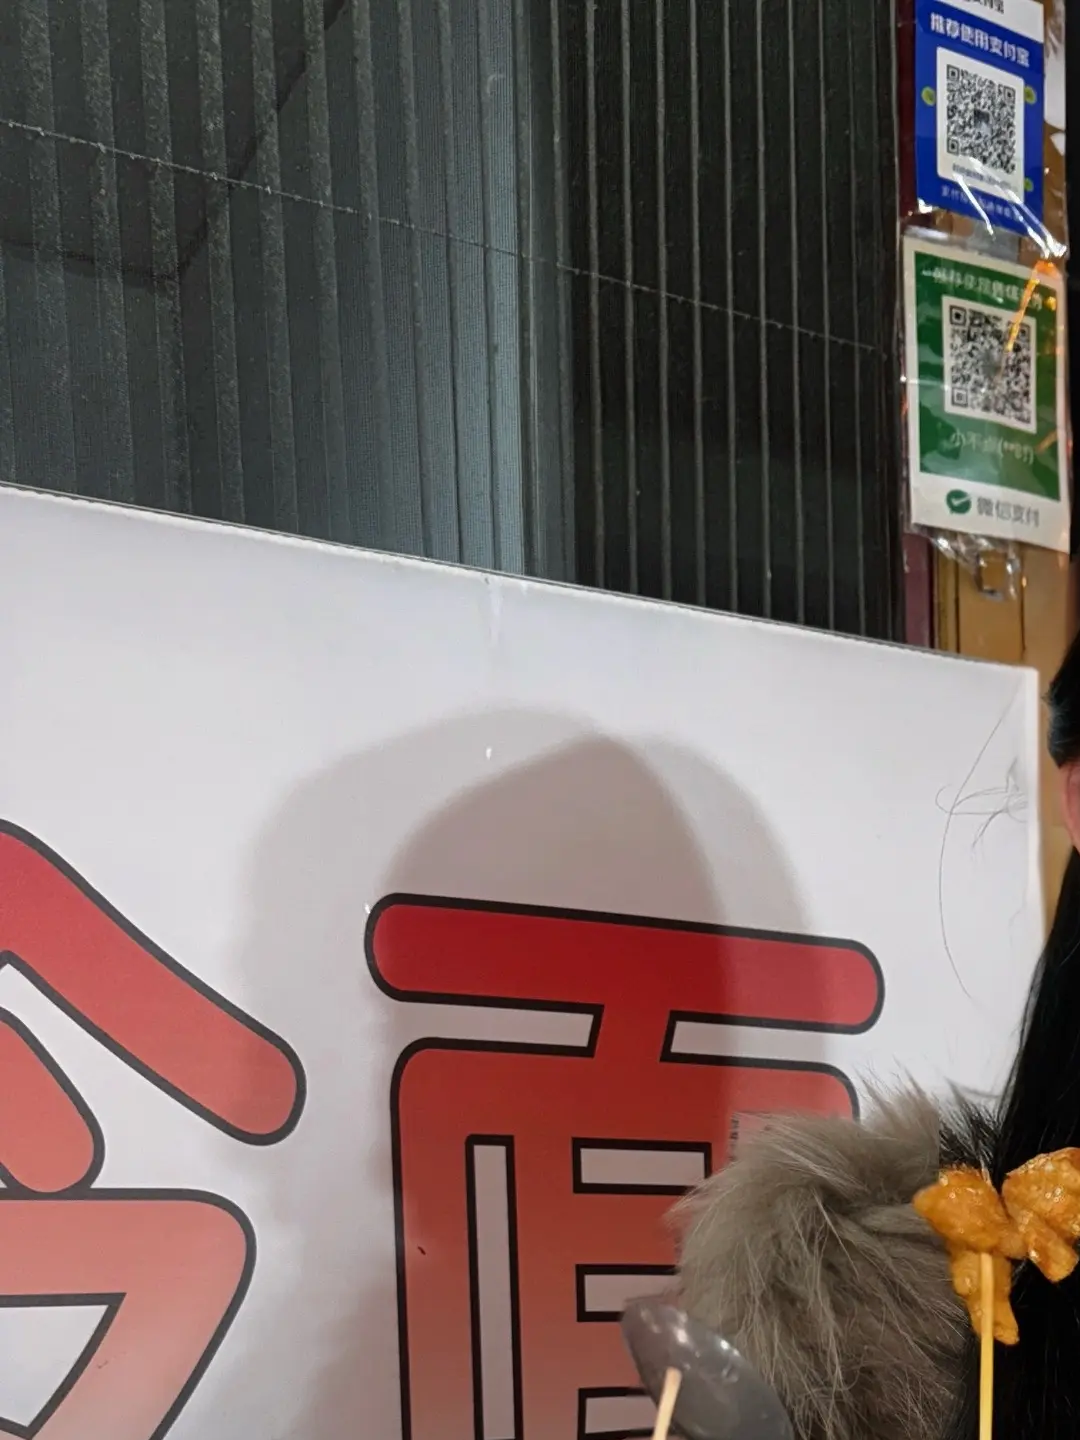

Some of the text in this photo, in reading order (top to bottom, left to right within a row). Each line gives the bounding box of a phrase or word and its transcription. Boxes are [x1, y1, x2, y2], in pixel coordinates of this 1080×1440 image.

[930, 12, 1030, 68] 推荐使用支付宝
[976, 496, 1040, 527] 微信支付
